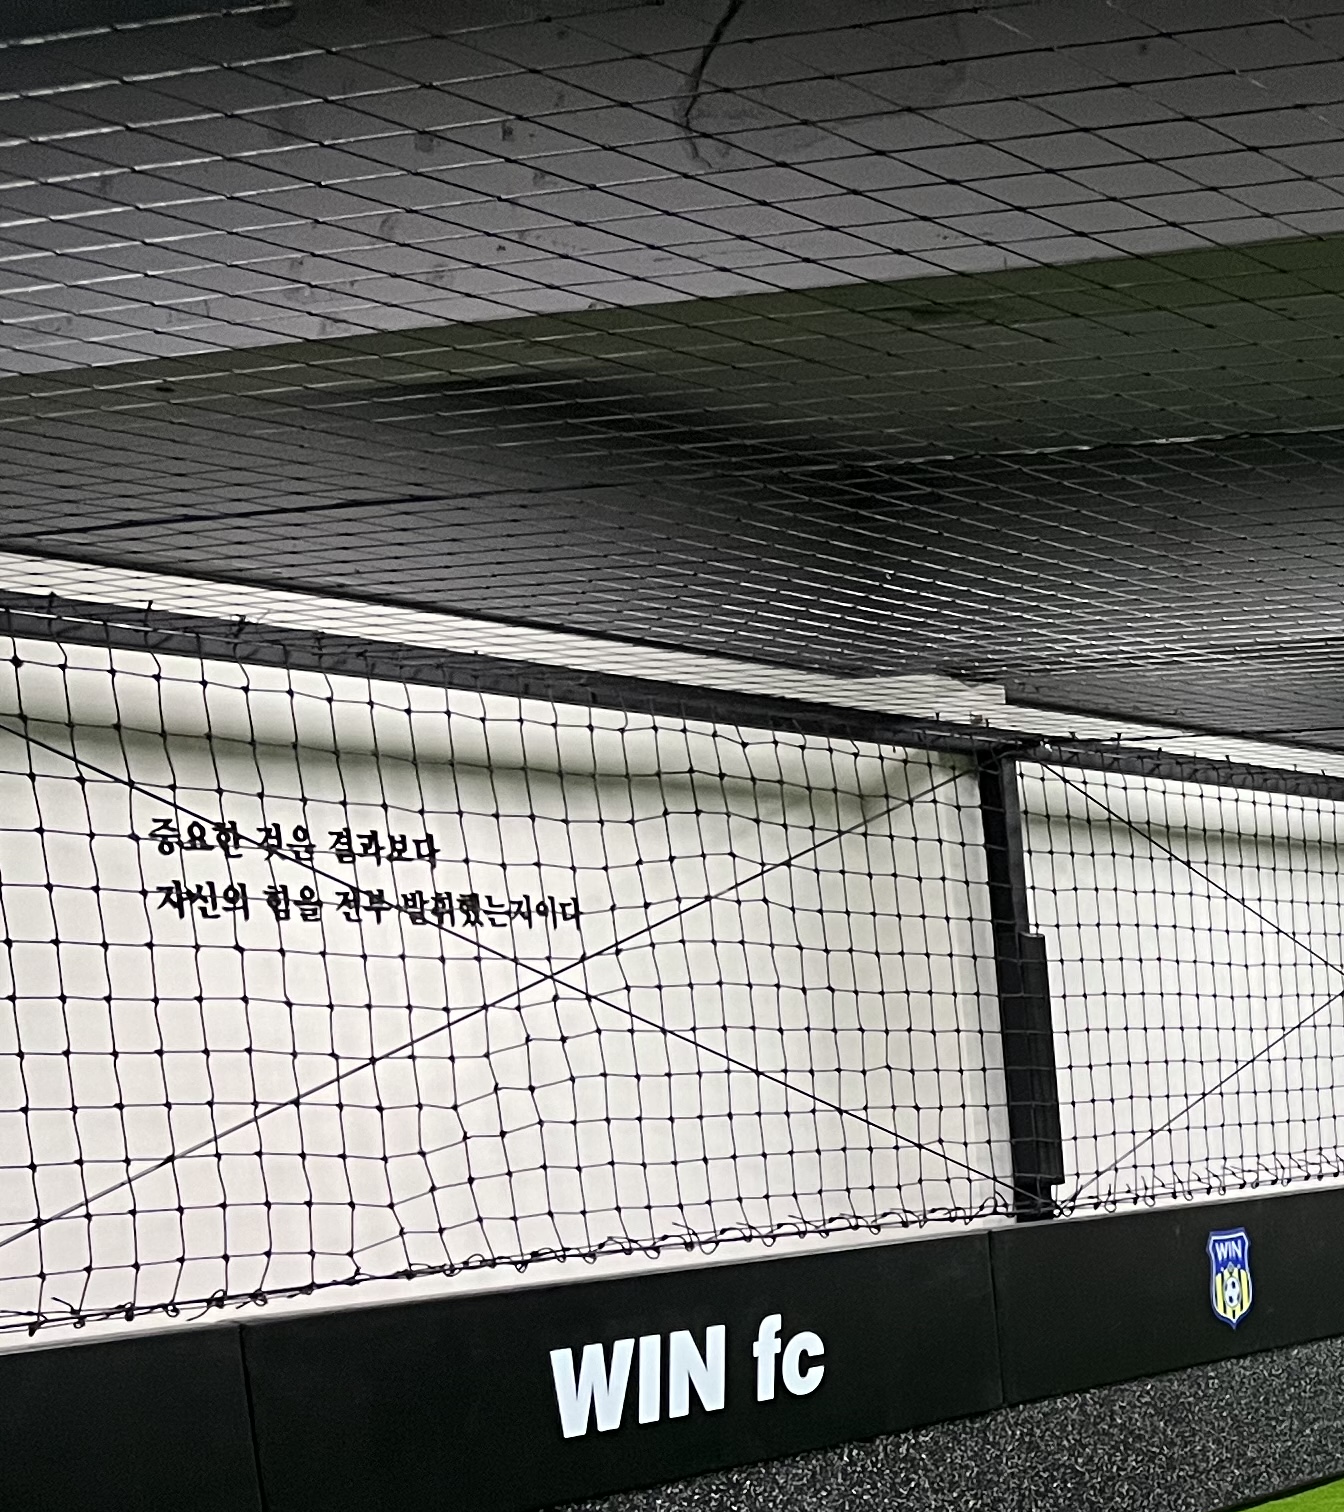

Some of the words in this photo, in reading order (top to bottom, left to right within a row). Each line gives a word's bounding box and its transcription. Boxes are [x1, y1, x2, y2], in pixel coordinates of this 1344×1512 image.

[148, 818, 243, 858] 중요한
[328, 828, 441, 869] 결과보다
[157, 880, 250, 921] 자신의
[263, 885, 323, 922] 힘을
[335, 886, 393, 924] 전부
[1215, 1239, 1242, 1262] WIN
[549, 1324, 726, 1439] WIN
[752, 1313, 825, 1402] fc
